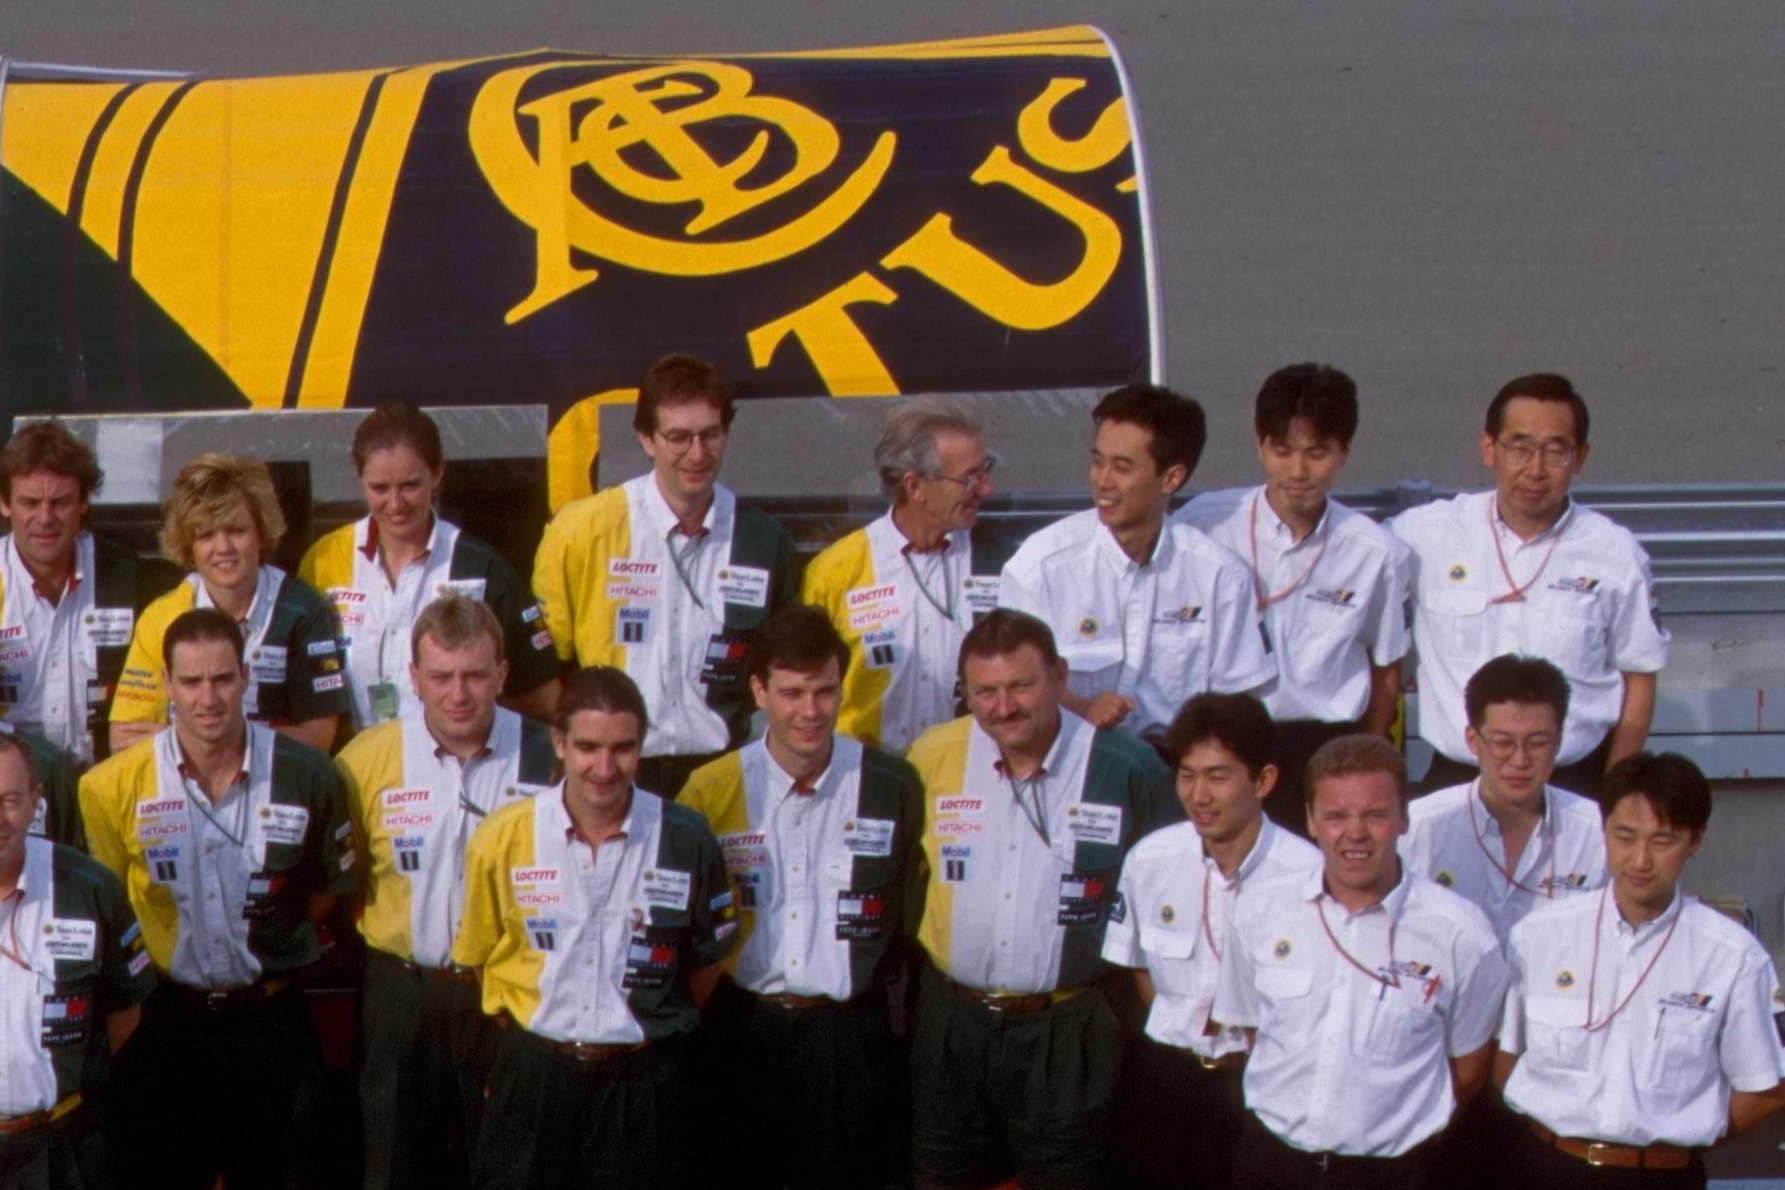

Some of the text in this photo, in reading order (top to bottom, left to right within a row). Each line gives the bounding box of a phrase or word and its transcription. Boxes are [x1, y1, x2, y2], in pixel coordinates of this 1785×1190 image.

[747, 77, 1140, 397] TUS
[613, 561, 657, 575] LOCTITE
[611, 585, 658, 597] HITACHI
[851, 586, 896, 605] LOCTITE
[619, 607, 648, 619] Mobil
[853, 607, 899, 626] HITACHI
[864, 630, 896, 645] Mobil
[387, 791, 430, 805] LOCTITE
[940, 799, 982, 810] LOCTITE
[141, 801, 184, 813] LOCTITE
[386, 813, 432, 826] HITACHI
[141, 823, 186, 837] HITACHI
[938, 821, 981, 832] HITACHI
[394, 837, 423, 849] Mobil
[720, 834, 766, 847] LOCTITE
[148, 847, 178, 860] Mobil
[941, 846, 970, 858] Mobil
[516, 870, 556, 881] LOCTITE
[527, 919, 556, 930] Mobil
